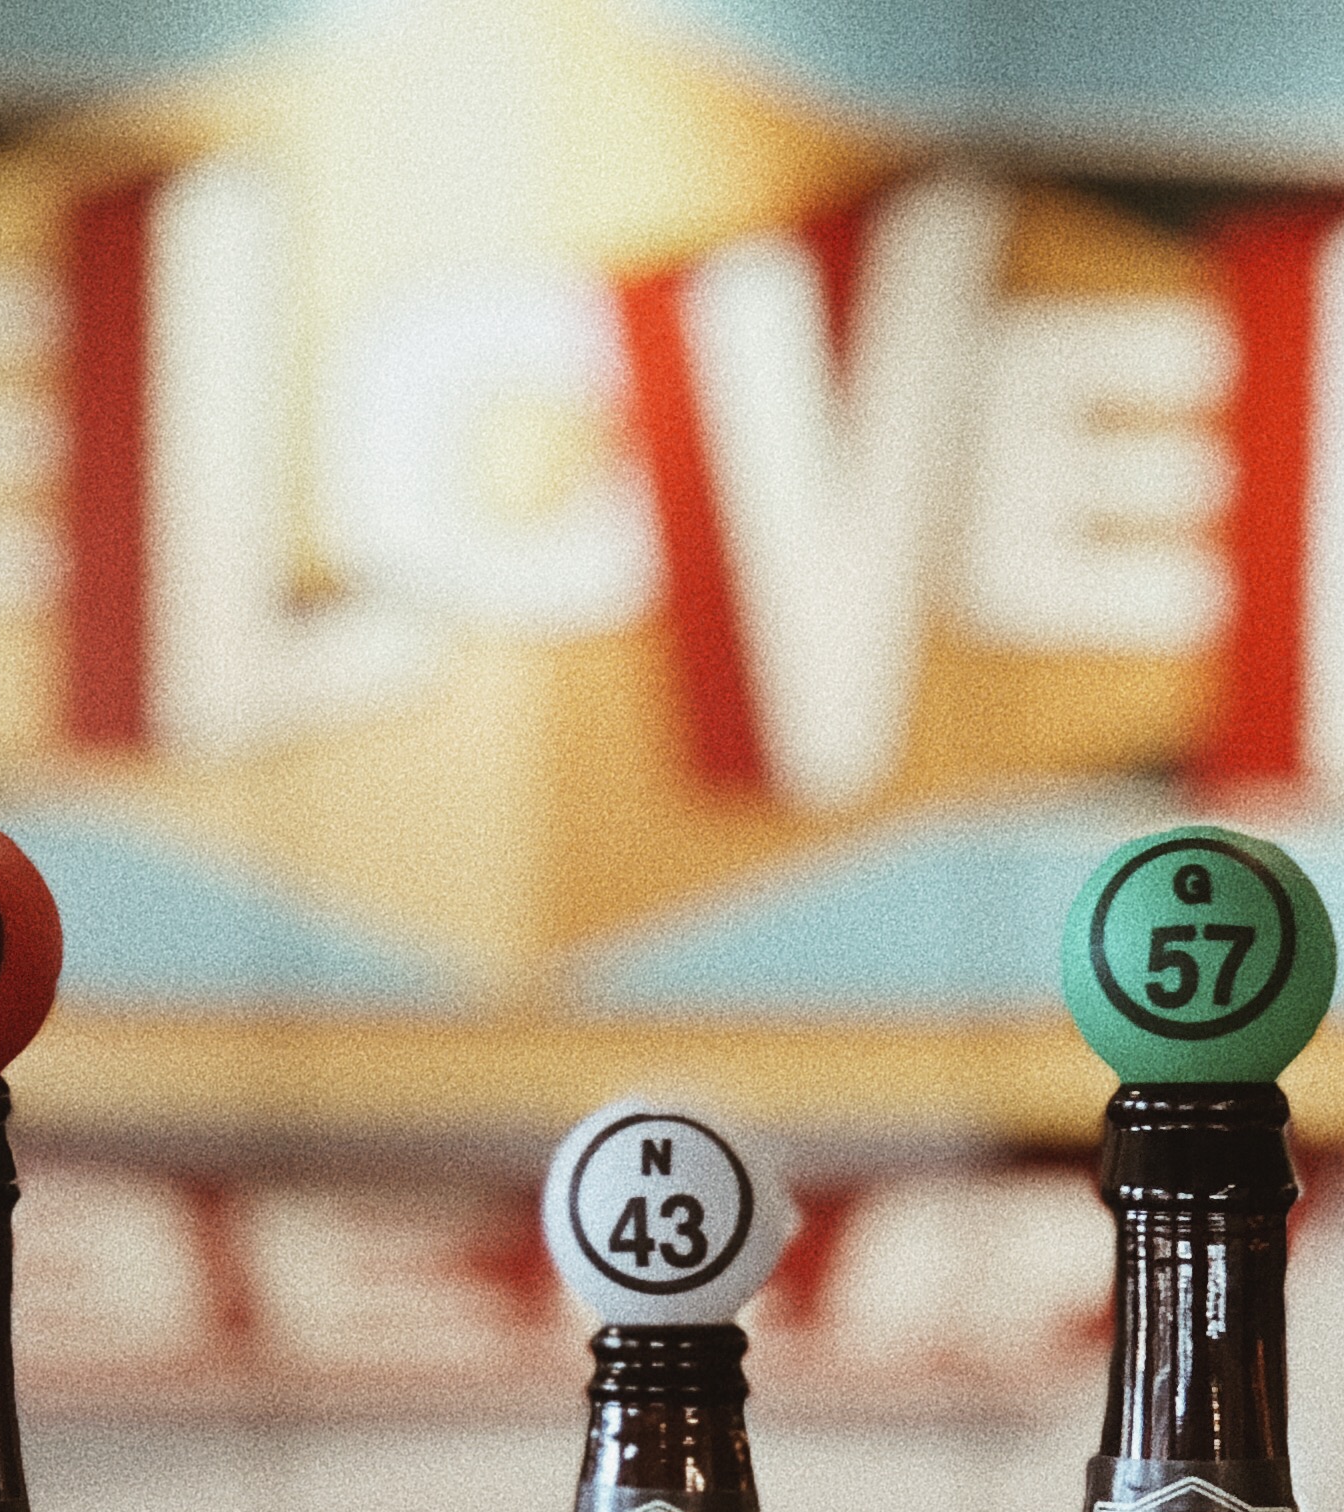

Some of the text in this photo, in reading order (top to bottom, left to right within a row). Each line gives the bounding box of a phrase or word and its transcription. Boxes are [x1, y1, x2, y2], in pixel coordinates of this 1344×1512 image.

[1173, 864, 1212, 904] G
[1145, 924, 1256, 1009] 57
[641, 1138, 672, 1176] N
[608, 1194, 708, 1268] 43
